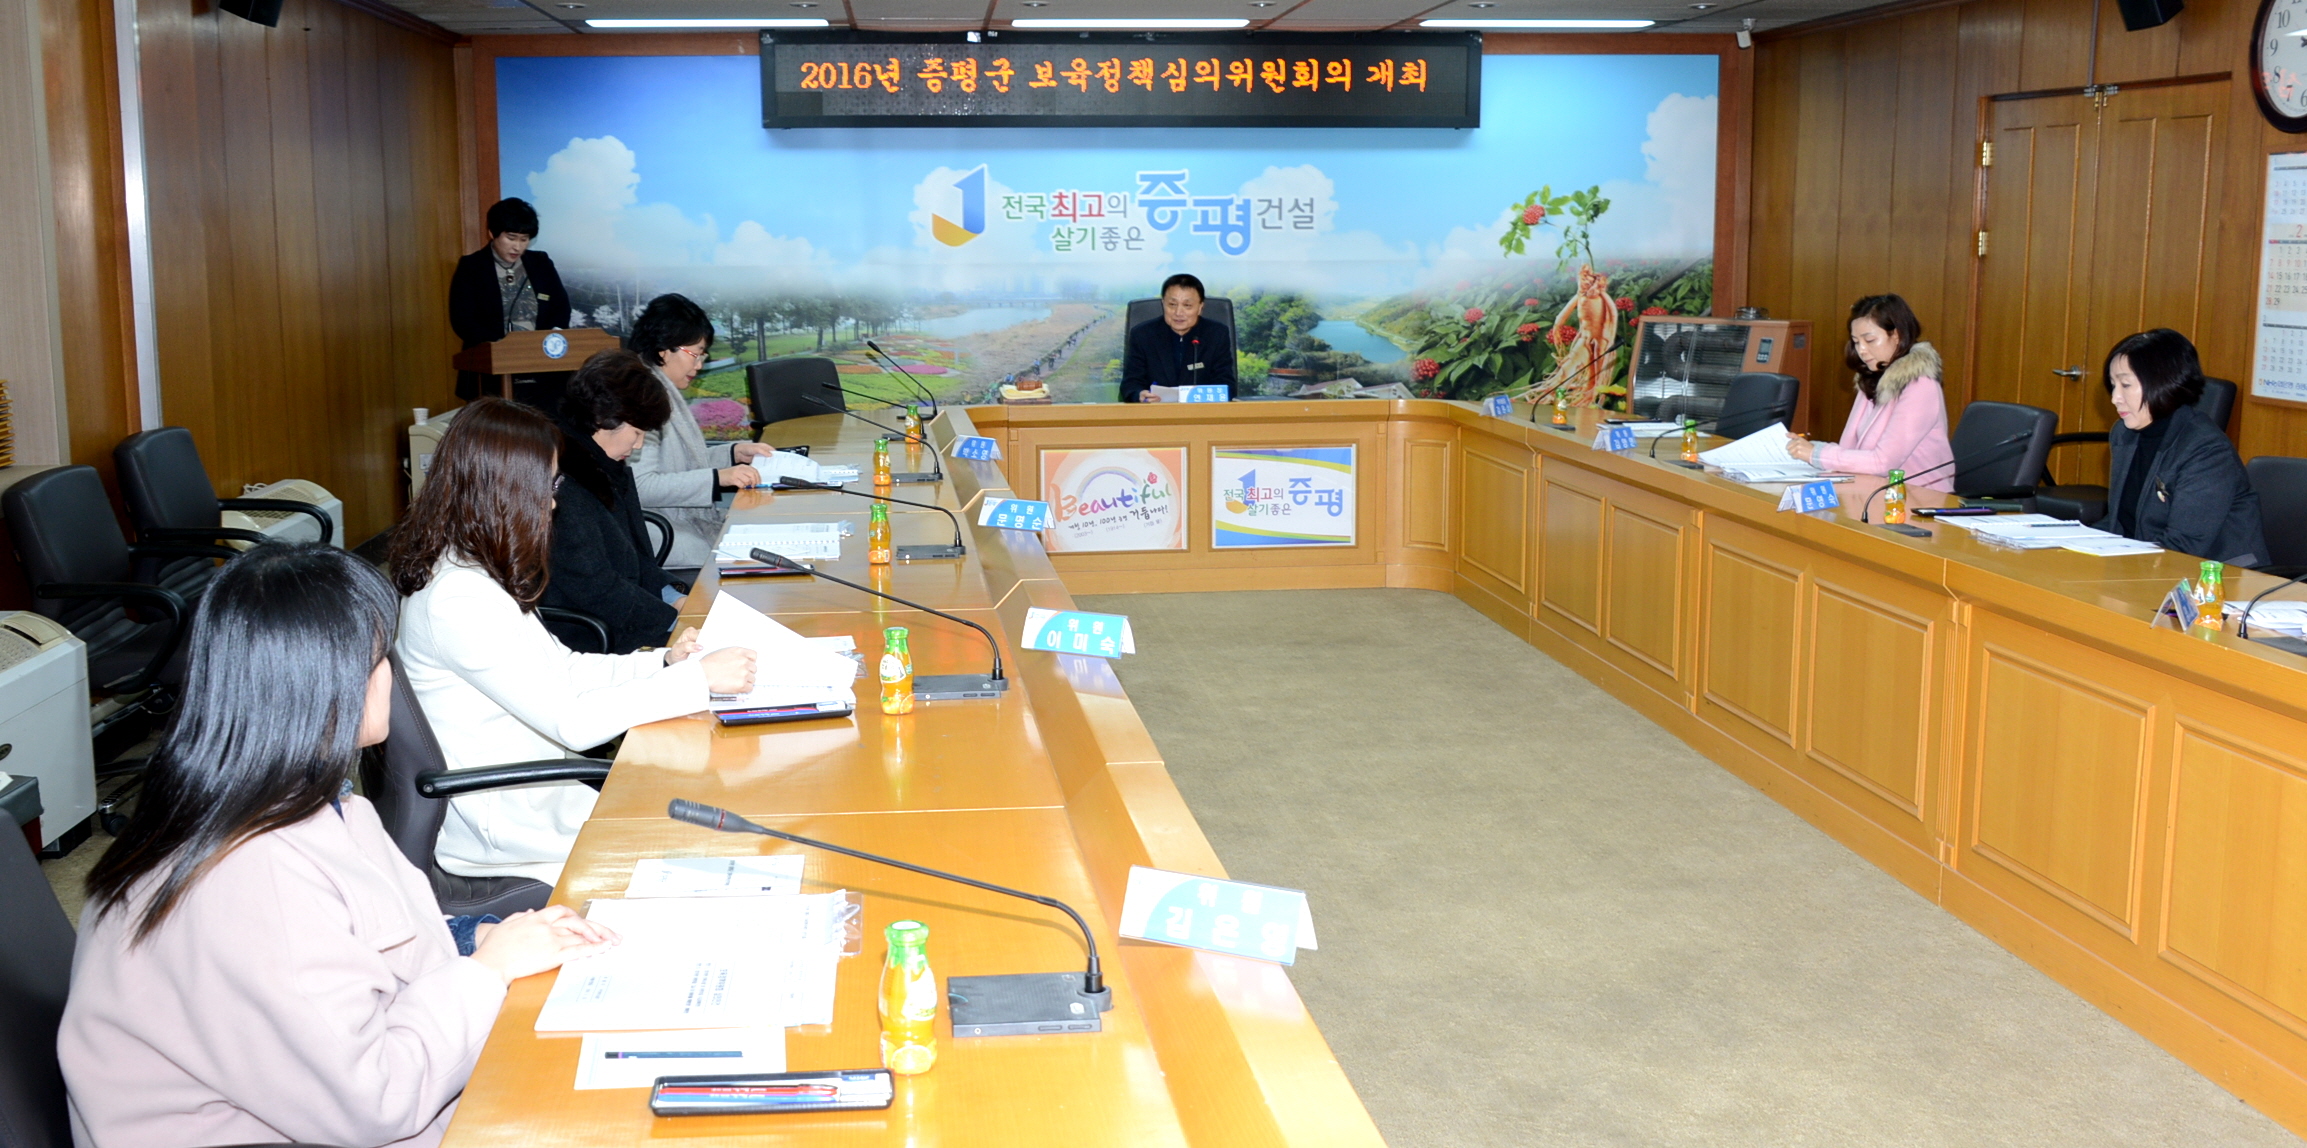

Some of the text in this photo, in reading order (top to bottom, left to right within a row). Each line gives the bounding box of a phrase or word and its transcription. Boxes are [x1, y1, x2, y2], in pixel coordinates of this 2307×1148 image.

[2278, 9, 2290, 28] 10
[2270, 38, 2278, 56] 9
[800, 57, 1428, 93] 2016년 증평군 보육정책심의위원회의 개최
[2273, 66, 2281, 83] 8
[2286, 84, 2293, 102] 7
[2296, 224, 2303, 238] 2
[1050, 476, 1172, 522] Beautiful
[1288, 477, 1343, 517] 증평
